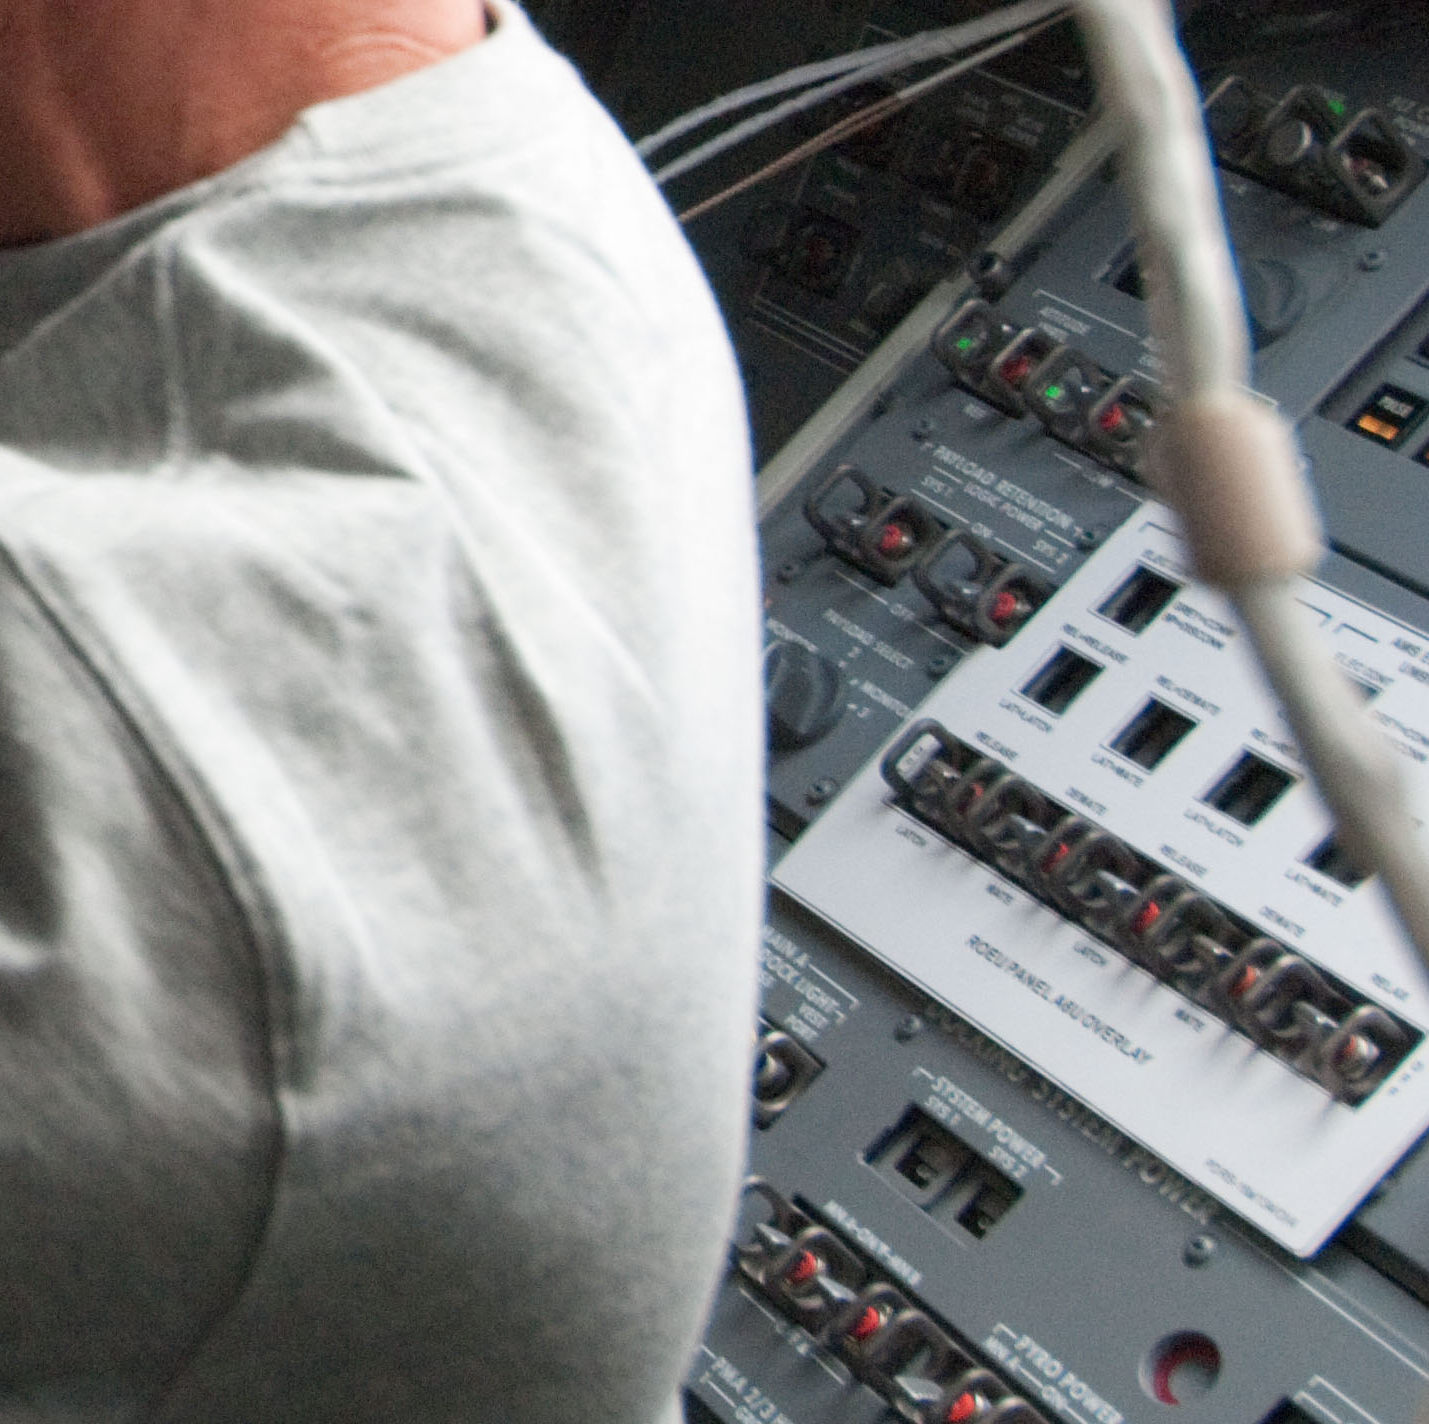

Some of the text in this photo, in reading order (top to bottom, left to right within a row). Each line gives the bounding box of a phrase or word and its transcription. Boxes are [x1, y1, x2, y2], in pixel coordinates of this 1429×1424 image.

[931, 441, 1075, 536] PAYLOAD RETENTION
[962, 479, 1044, 535] LOGIC POWER
[873, 640, 915, 671] SELECT
[972, 727, 1022, 765] RELEASE
[893, 822, 929, 850] LATCH
[1157, 841, 1209, 880] RELEASE
[1069, 938, 1110, 971] LATCH
[791, 974, 843, 1017] LIGHT
[963, 931, 1010, 970] ROEU
[1001, 957, 1058, 1003] PANEL
[1077, 1010, 1157, 1072] OVERLAY
[925, 1071, 1050, 1171] SYSTEM POWER
[1117, 1145, 1220, 1228] POWER
[1010, 1332, 1131, 1424] PYRO POWER
